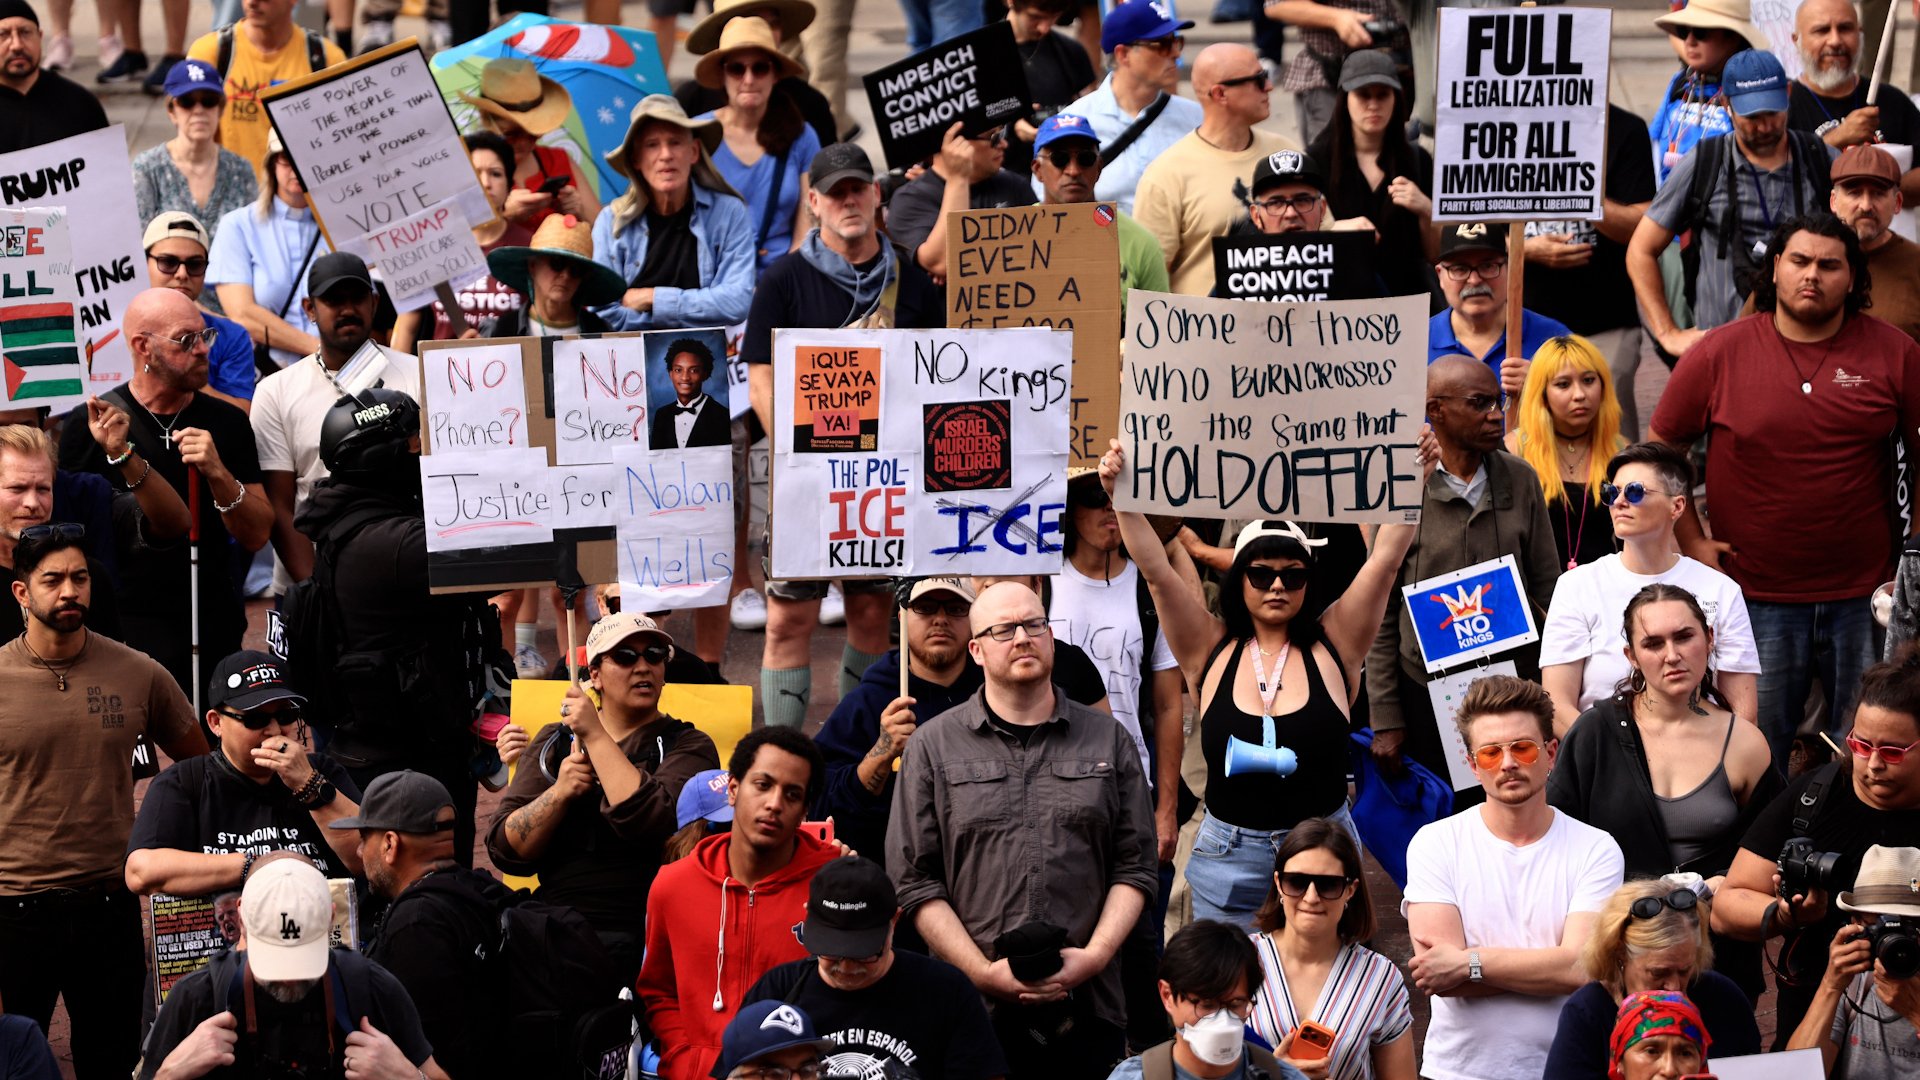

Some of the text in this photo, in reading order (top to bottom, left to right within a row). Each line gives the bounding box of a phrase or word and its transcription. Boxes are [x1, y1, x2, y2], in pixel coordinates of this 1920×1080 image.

[1466, 13, 1583, 77] FULL
[280, 61, 410, 117] THE POWER OF
[878, 44, 976, 98] IMPEACH
[312, 88, 395, 131] THE PEOPLE
[884, 65, 978, 118] CONVICT
[985, 101, 1021, 117] COALITION
[1451, 78, 1594, 109] LEGALIZATION
[310, 89, 433, 150] IS STRONGER THAN
[889, 88, 981, 140] REMOVE
[357, 128, 382, 144] THE
[1462, 120, 1576, 160] FOR ALL
[311, 158, 353, 184] PEOPLE
[378, 127, 432, 156] POWER
[328, 149, 450, 204] USE YOUR VOICE
[1441, 161, 1596, 195] IMMIGRANTS
[346, 181, 440, 233] VOTE
[1441, 198, 1590, 212] PARTY FOR SOCIALISM & LIBERATION
[368, 207, 449, 252] TRUMP
[962, 208, 1068, 244] DIDN'T
[429, 233, 457, 257] CARE
[959, 239, 1052, 278] EVEN
[1226, 243, 1334, 269] IMPEACH
[393, 271, 431, 297] ABOUT
[437, 246, 477, 279] YOU!
[1227, 268, 1334, 293] CONVICT
[955, 276, 1081, 313] NEED A
[1136, 299, 1402, 349] Some of those
[914, 339, 969, 385] NO
[799, 370, 876, 391] SE VAYA
[1232, 363, 1302, 400] BURN
[354, 402, 390, 426] PRESS
[804, 390, 872, 412] TRUMP
[430, 404, 646, 451] Phone? Shoes?
[822, 414, 851, 432] YA!
[944, 418, 991, 438] ISRAEL
[1124, 411, 1173, 443] are
[1201, 411, 1251, 442] the
[1351, 407, 1408, 438] that
[934, 435, 1001, 455] MURDERS
[934, 452, 1001, 473] CHILDREN
[828, 458, 859, 488] THE
[866, 458, 909, 488] POL-
[1132, 442, 1422, 517] HOLD OFFICE
[428, 461, 731, 528] Justice for Nolan
[829, 487, 906, 541] ICE
[929, 503, 1065, 555] ICE
[624, 536, 733, 589] Wells
[829, 539, 904, 568] KILLS!
[1453, 615, 1490, 640] NO
[1458, 631, 1494, 649] KINGS
[250, 668, 277, 682] FDT
[217, 827, 280, 846] STANDIN
[822, 900, 867, 911] radio bilingüe
[157, 930, 211, 945] AND I REFUSE
[280, 912, 300, 940] LA
[157, 937, 224, 953] TO GET USED TO IT.
[168, 950, 189, 961] beyond
[848, 1028, 917, 1067] EN ESPAÑOL
